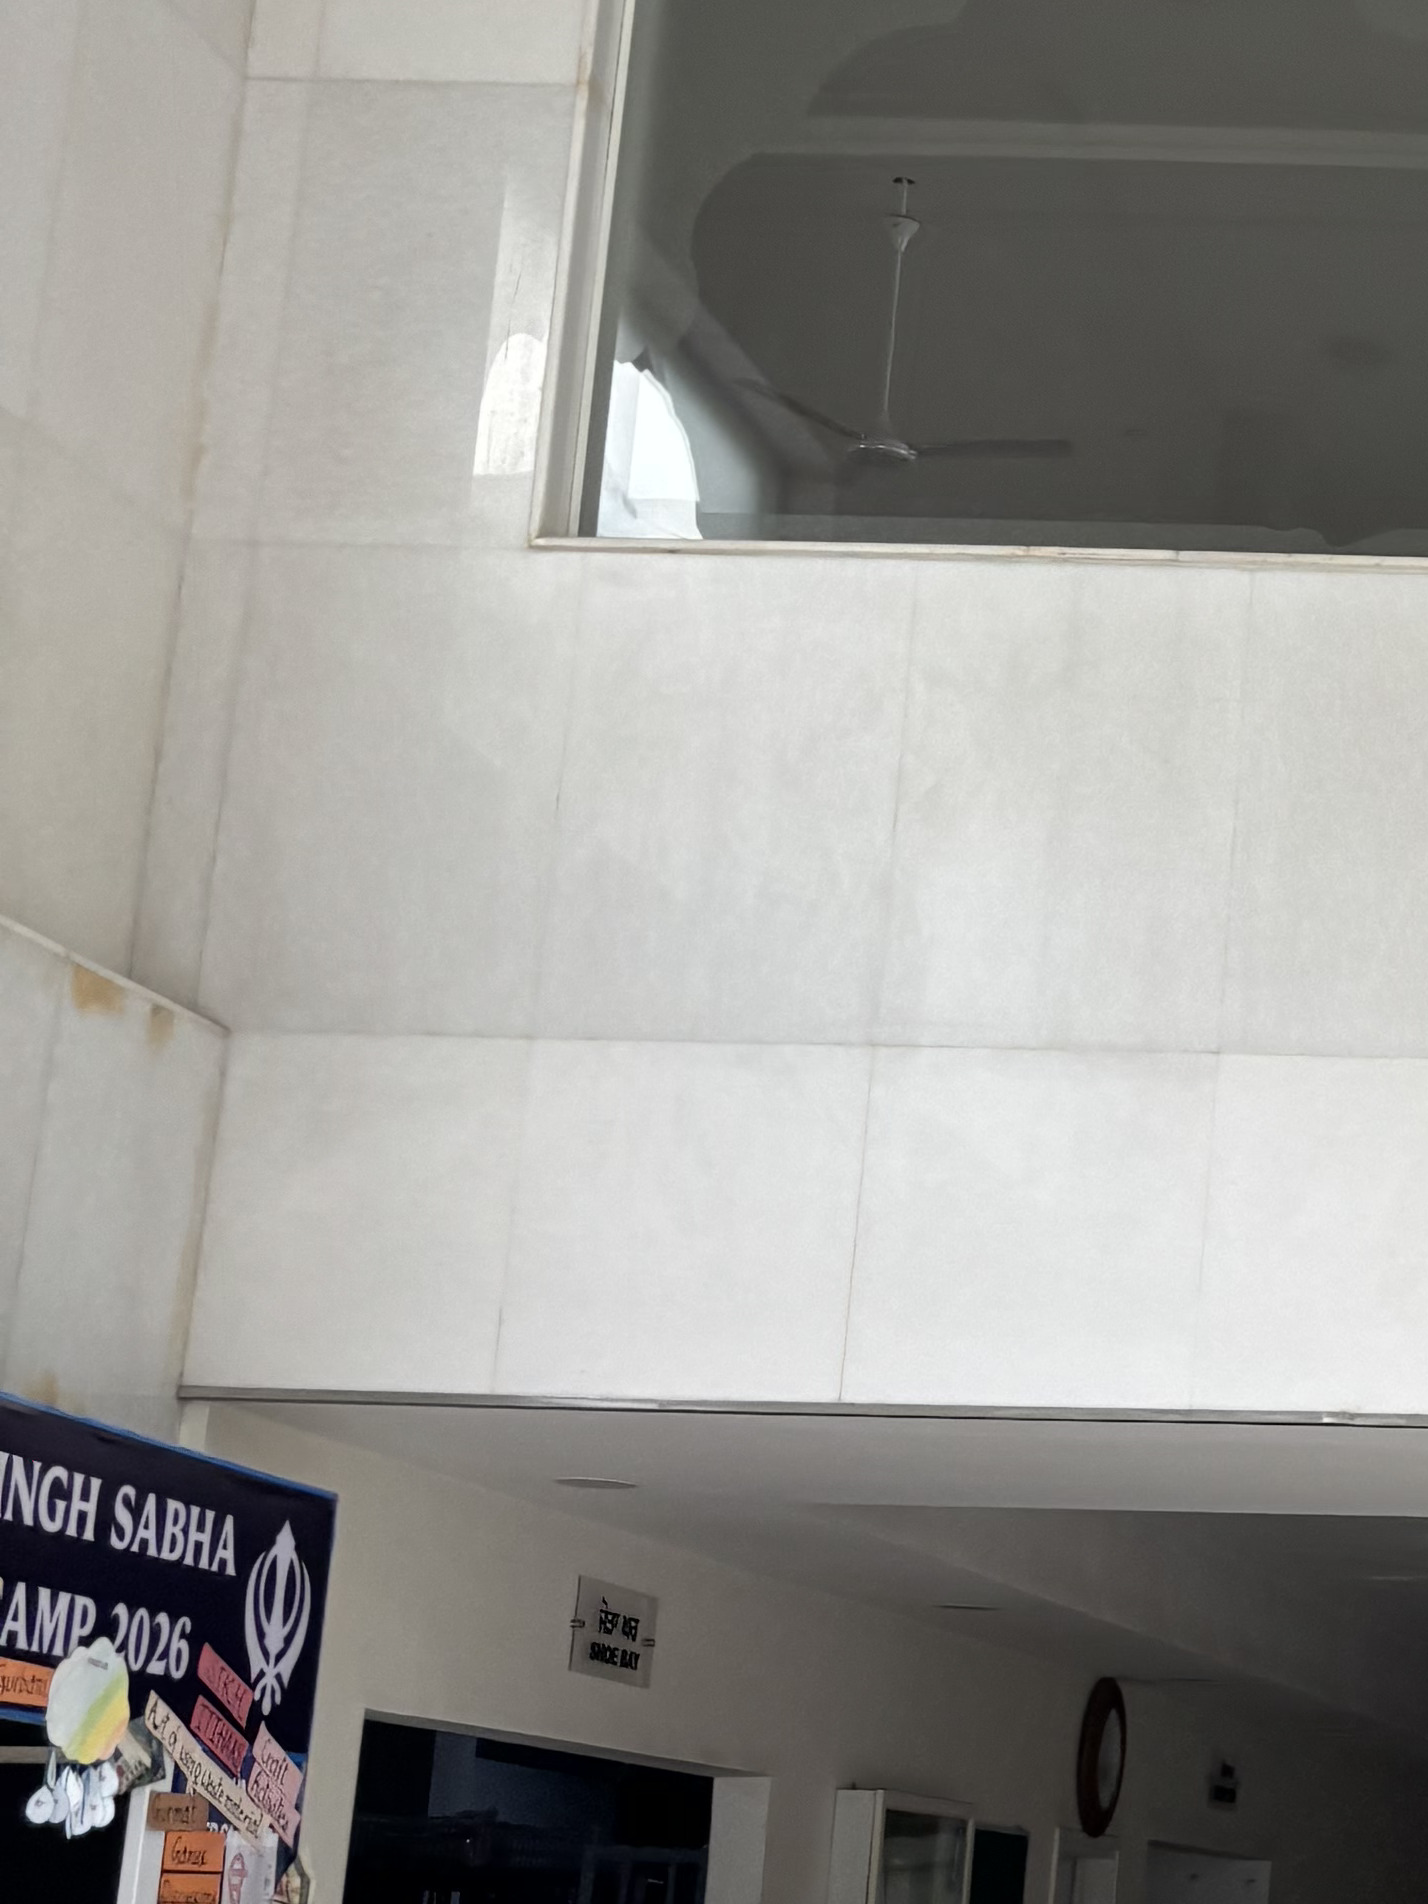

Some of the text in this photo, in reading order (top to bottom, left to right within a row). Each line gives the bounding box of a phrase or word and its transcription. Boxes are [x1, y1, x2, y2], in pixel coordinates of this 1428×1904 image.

[110, 1484, 236, 1577] SABHA
[0, 1576, 97, 1658] AMP
[110, 1602, 192, 1680] 2026
[589, 1641, 640, 1671] SHOE BAY
